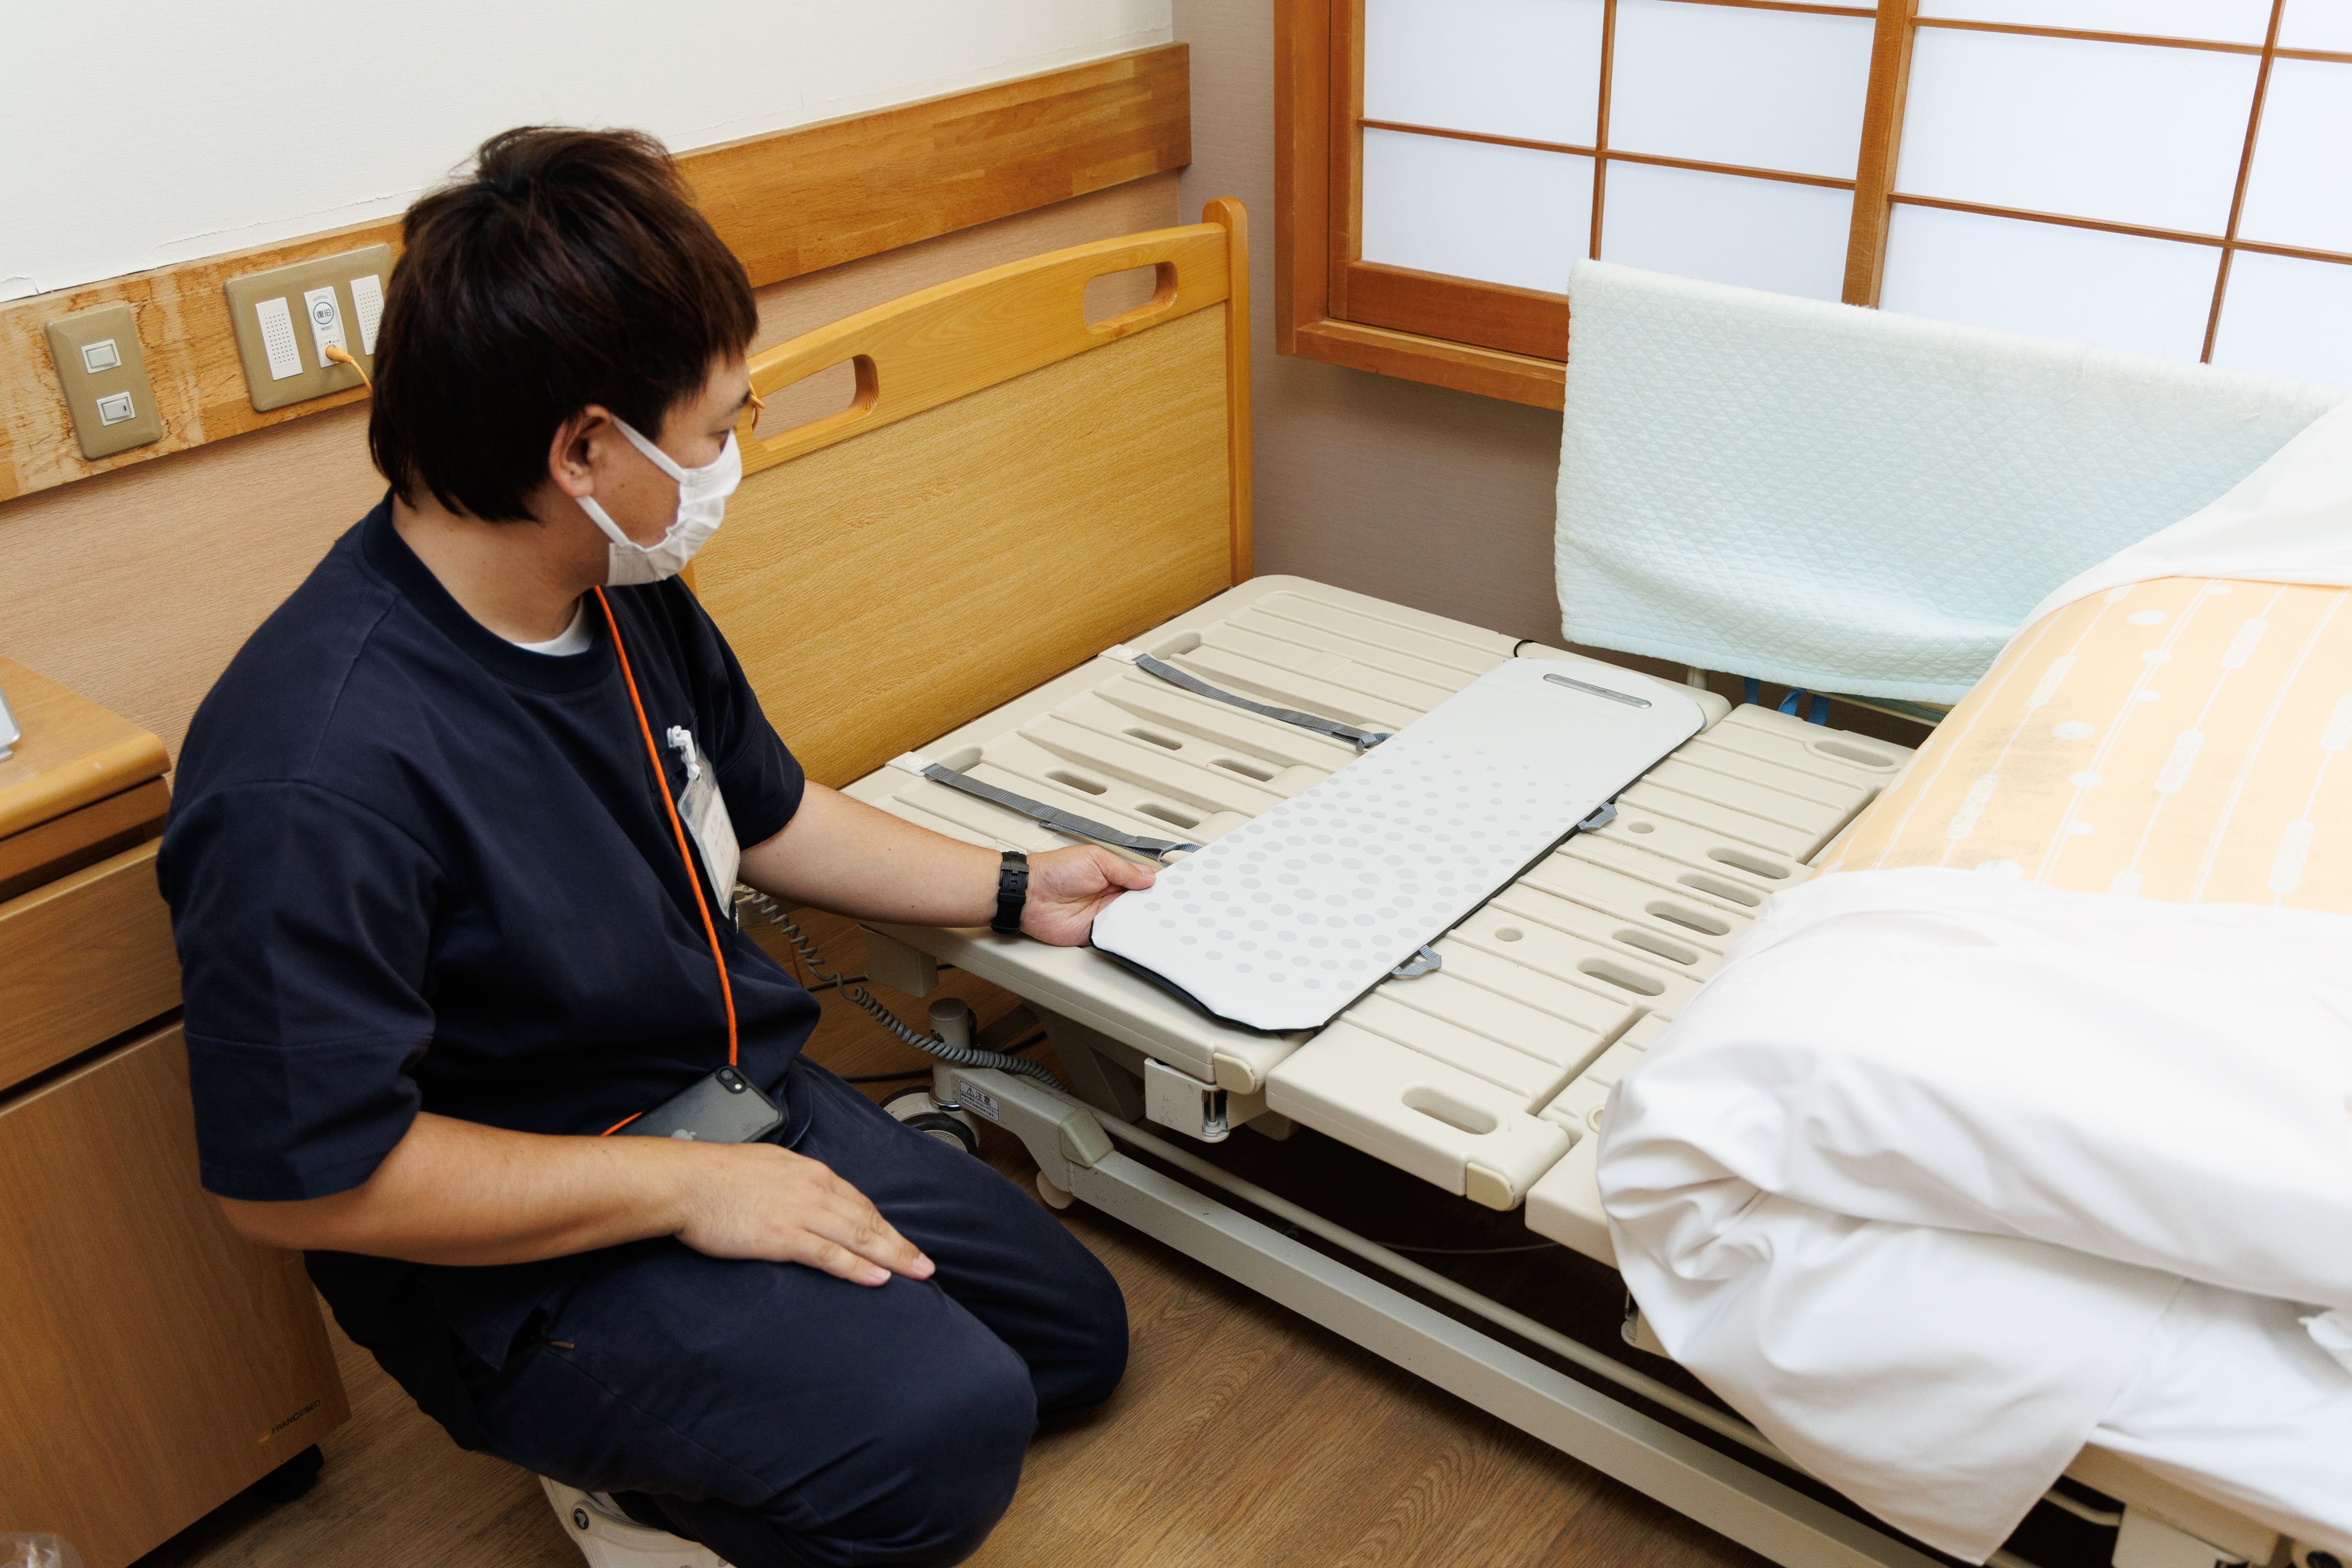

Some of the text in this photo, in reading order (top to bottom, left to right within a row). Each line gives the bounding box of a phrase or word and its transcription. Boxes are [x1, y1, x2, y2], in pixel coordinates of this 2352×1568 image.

[316, 308, 331, 319] 復旧
[975, 1090, 991, 1106] 注意
[272, 1400, 320, 1434] FRANCEBED
